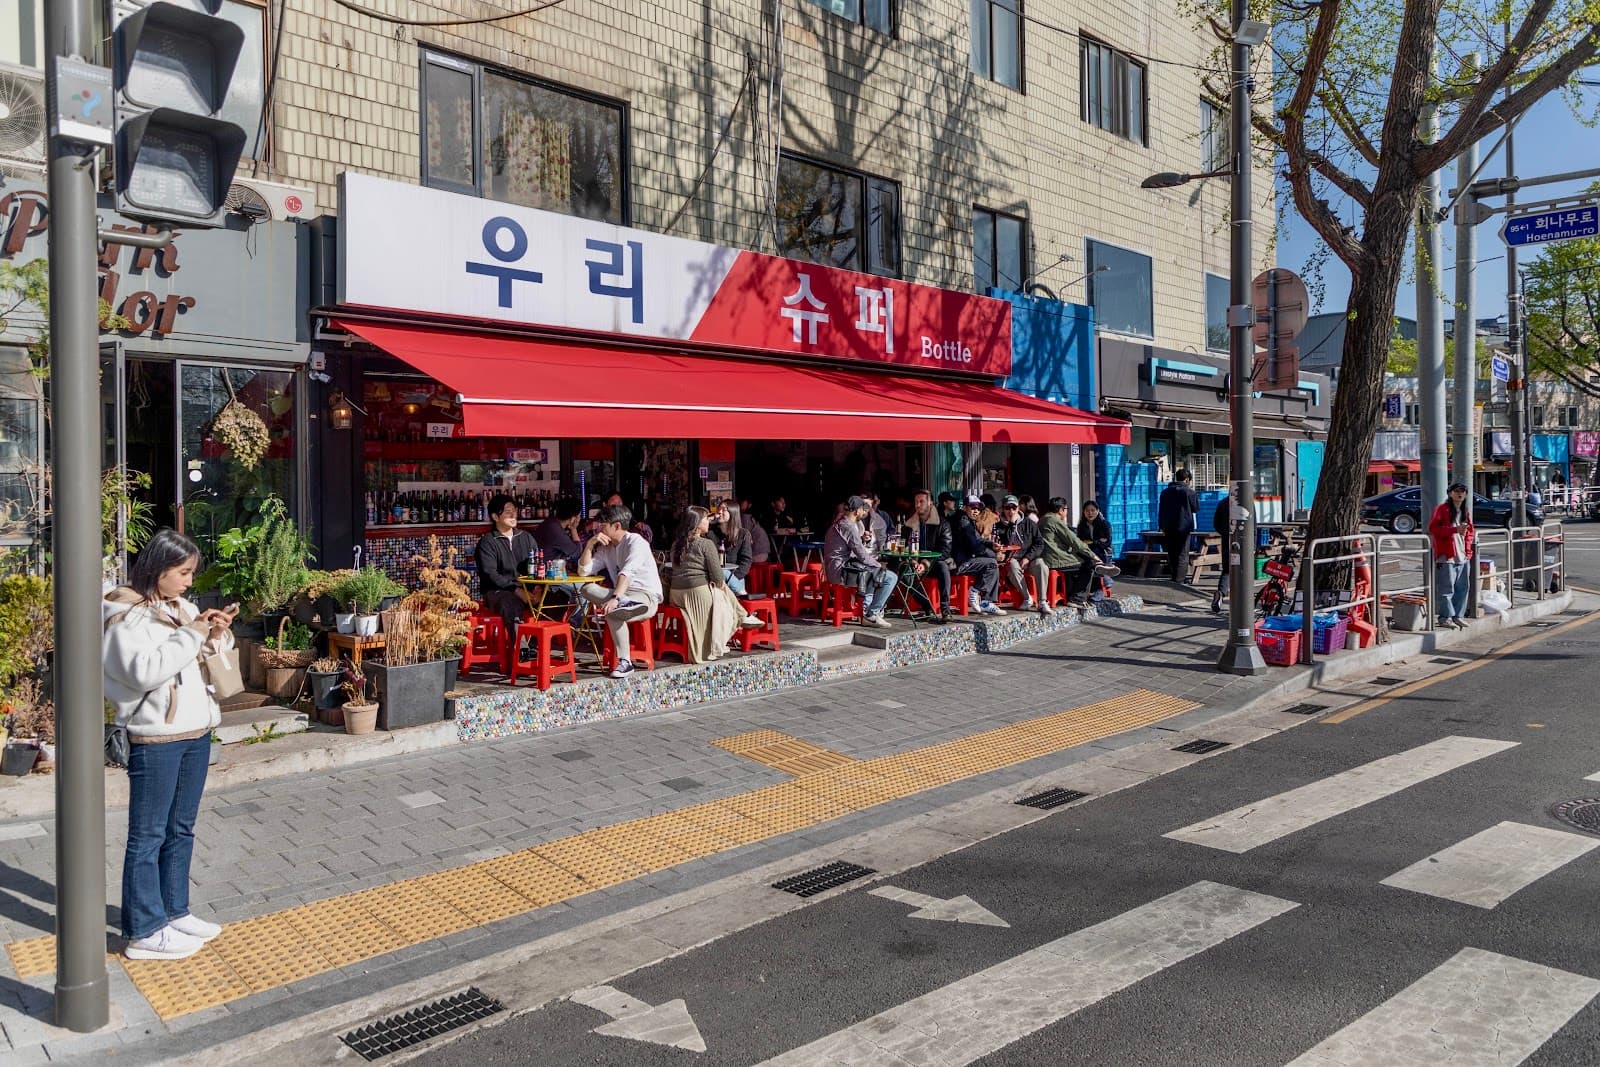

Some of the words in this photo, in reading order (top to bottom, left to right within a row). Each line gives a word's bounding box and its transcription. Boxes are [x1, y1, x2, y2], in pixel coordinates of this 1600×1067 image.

[1535, 211, 1595, 229] 회나무로
[1526, 227, 1595, 242] Hoenamu-ro
[466, 215, 645, 324] 우리
[781, 272, 895, 354] 슈퍼
[921, 335, 972, 363] Bottle
[431, 425, 448, 436] 우리
